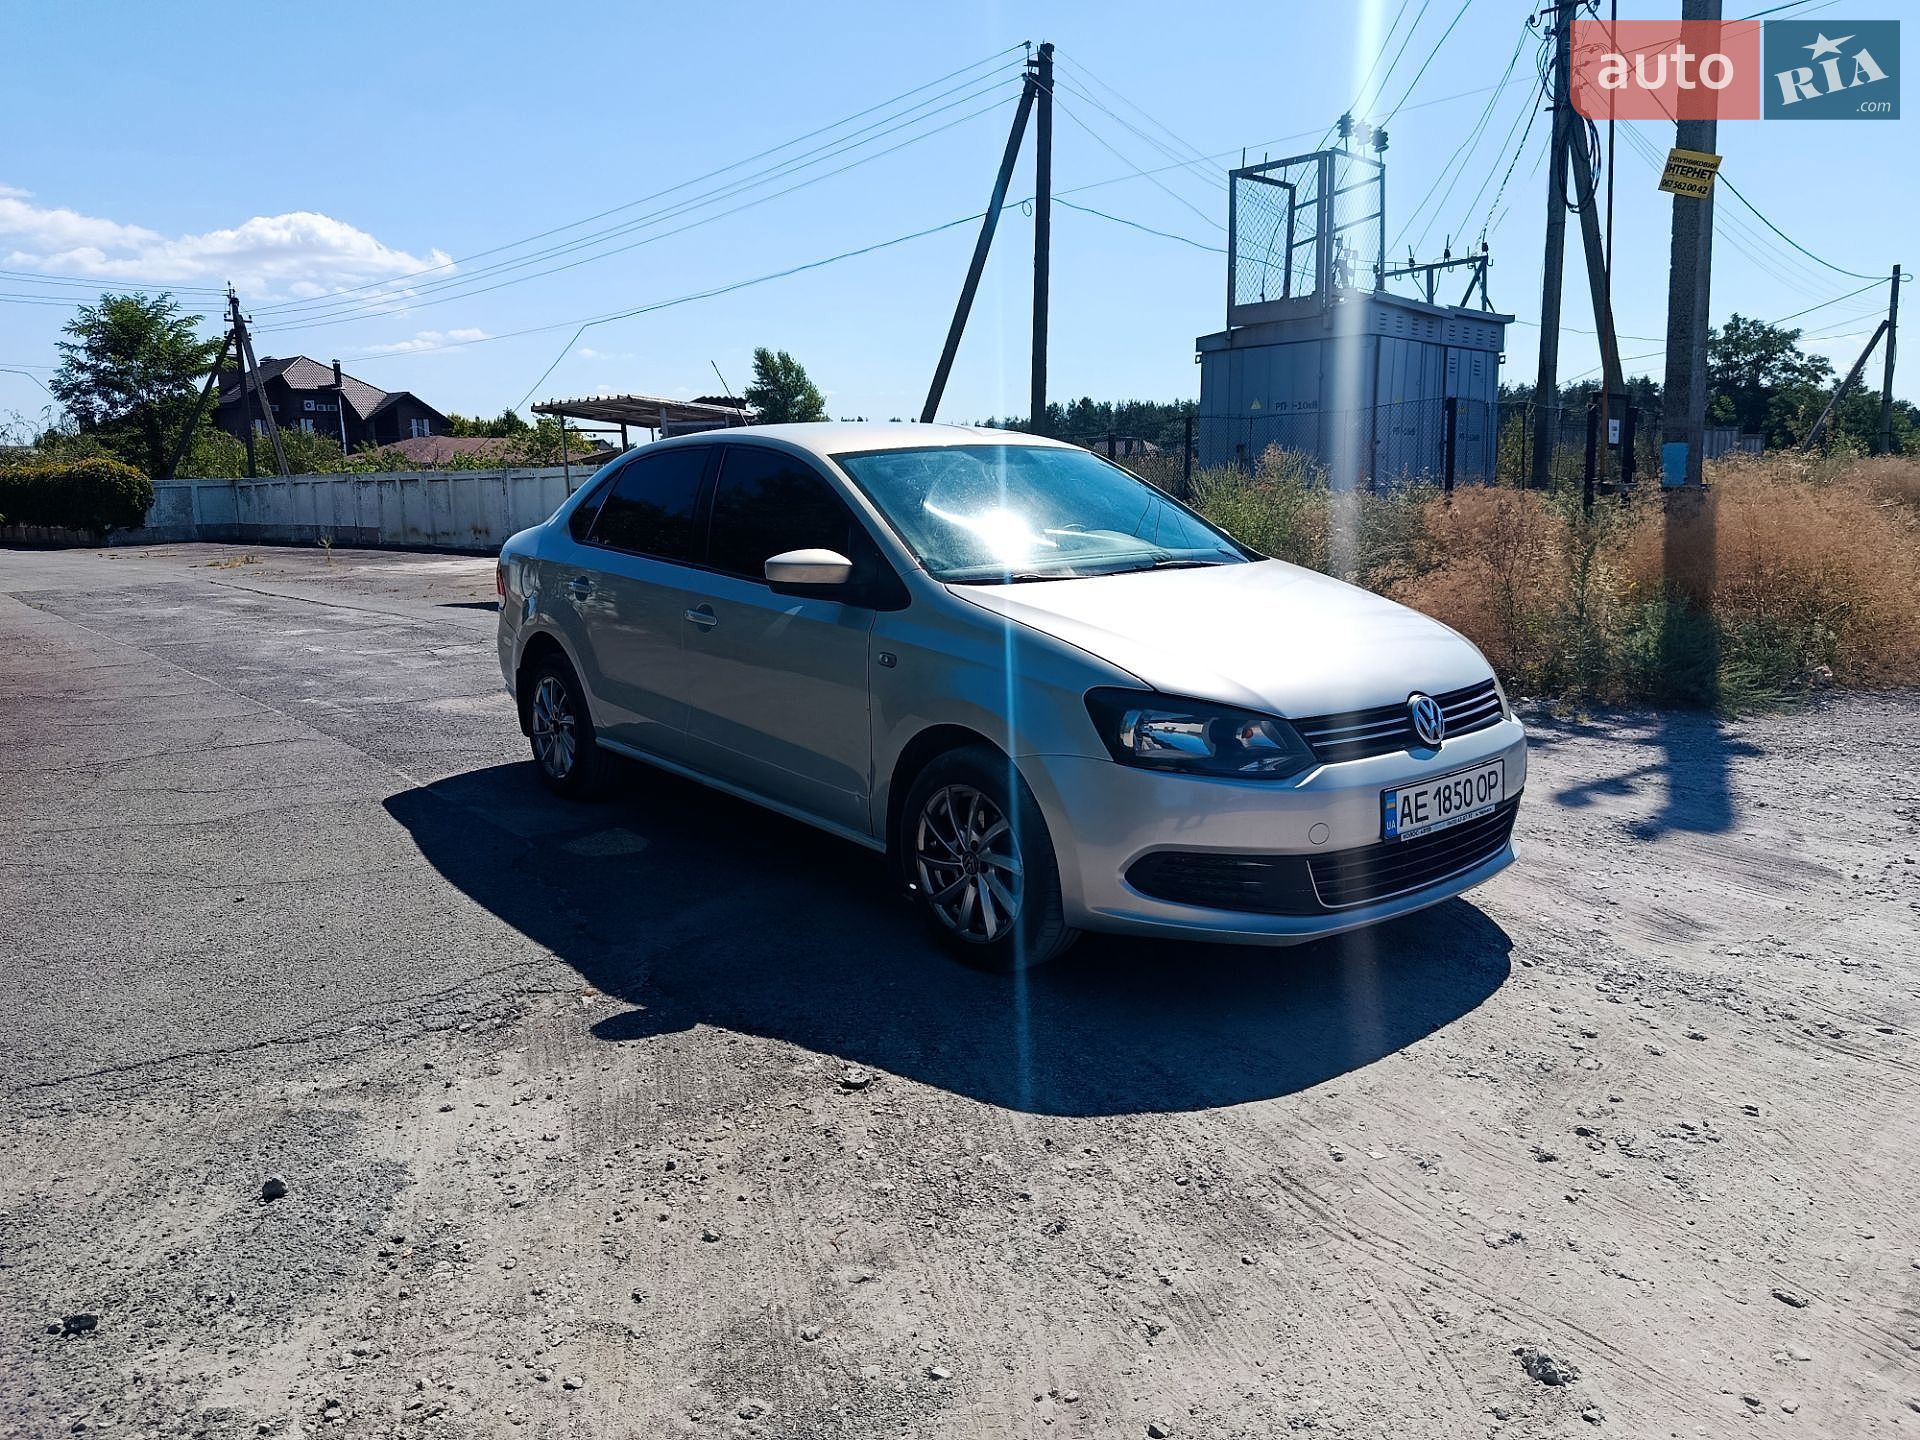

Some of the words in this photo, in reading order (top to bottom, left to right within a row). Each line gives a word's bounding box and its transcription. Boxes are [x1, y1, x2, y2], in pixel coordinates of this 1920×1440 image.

[1673, 181, 1686, 191] 562
[1687, 183, 1697, 192] 00
[1697, 185, 1707, 195] 42
[1400, 790, 1429, 827] AE
[1433, 778, 1474, 817] 1850
[1477, 770, 1498, 802] OP
[1386, 819, 1396, 831] UA
